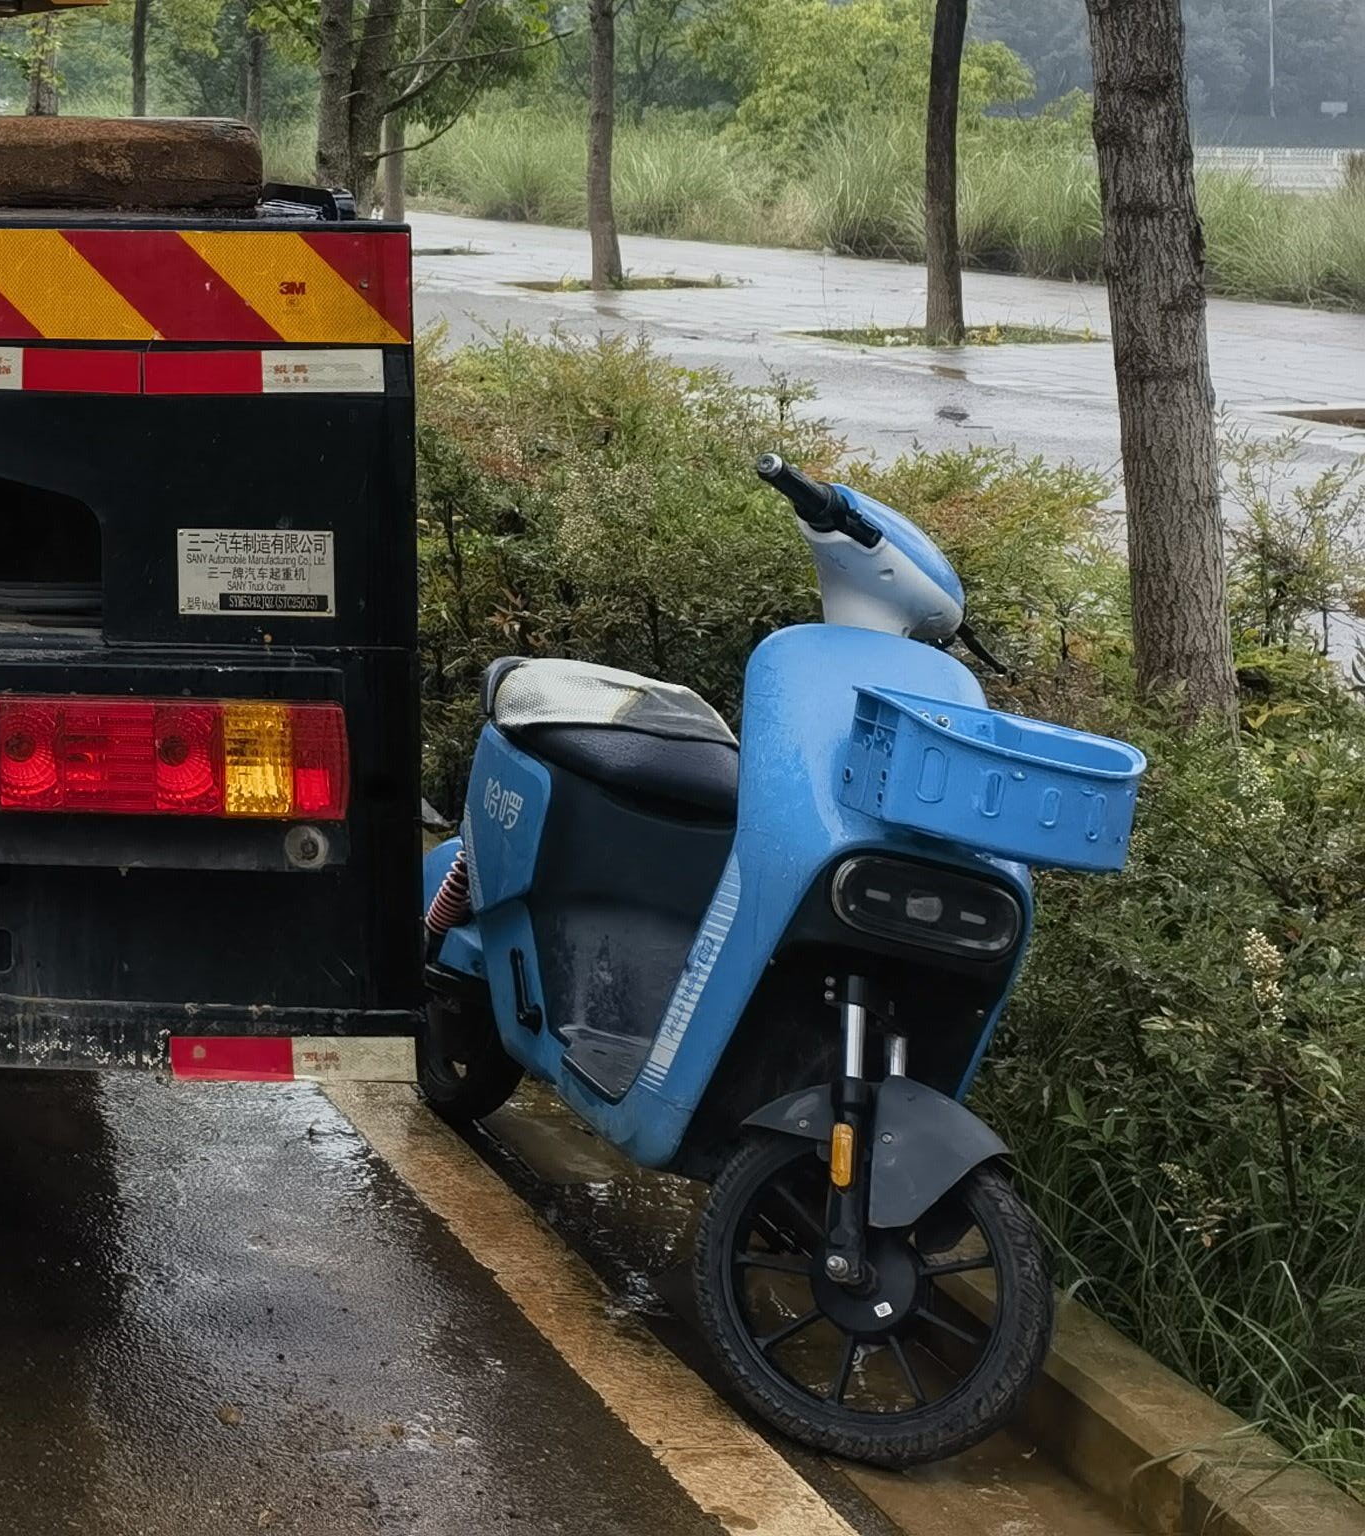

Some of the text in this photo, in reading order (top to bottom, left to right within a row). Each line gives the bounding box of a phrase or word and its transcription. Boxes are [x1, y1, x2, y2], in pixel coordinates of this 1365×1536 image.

[279, 282, 306, 295] 3M
[187, 532, 327, 555] 三一汽车制造有限公司
[207, 567, 306, 581] 三一牌汽车起重机
[268, 582, 286, 592] Crane
